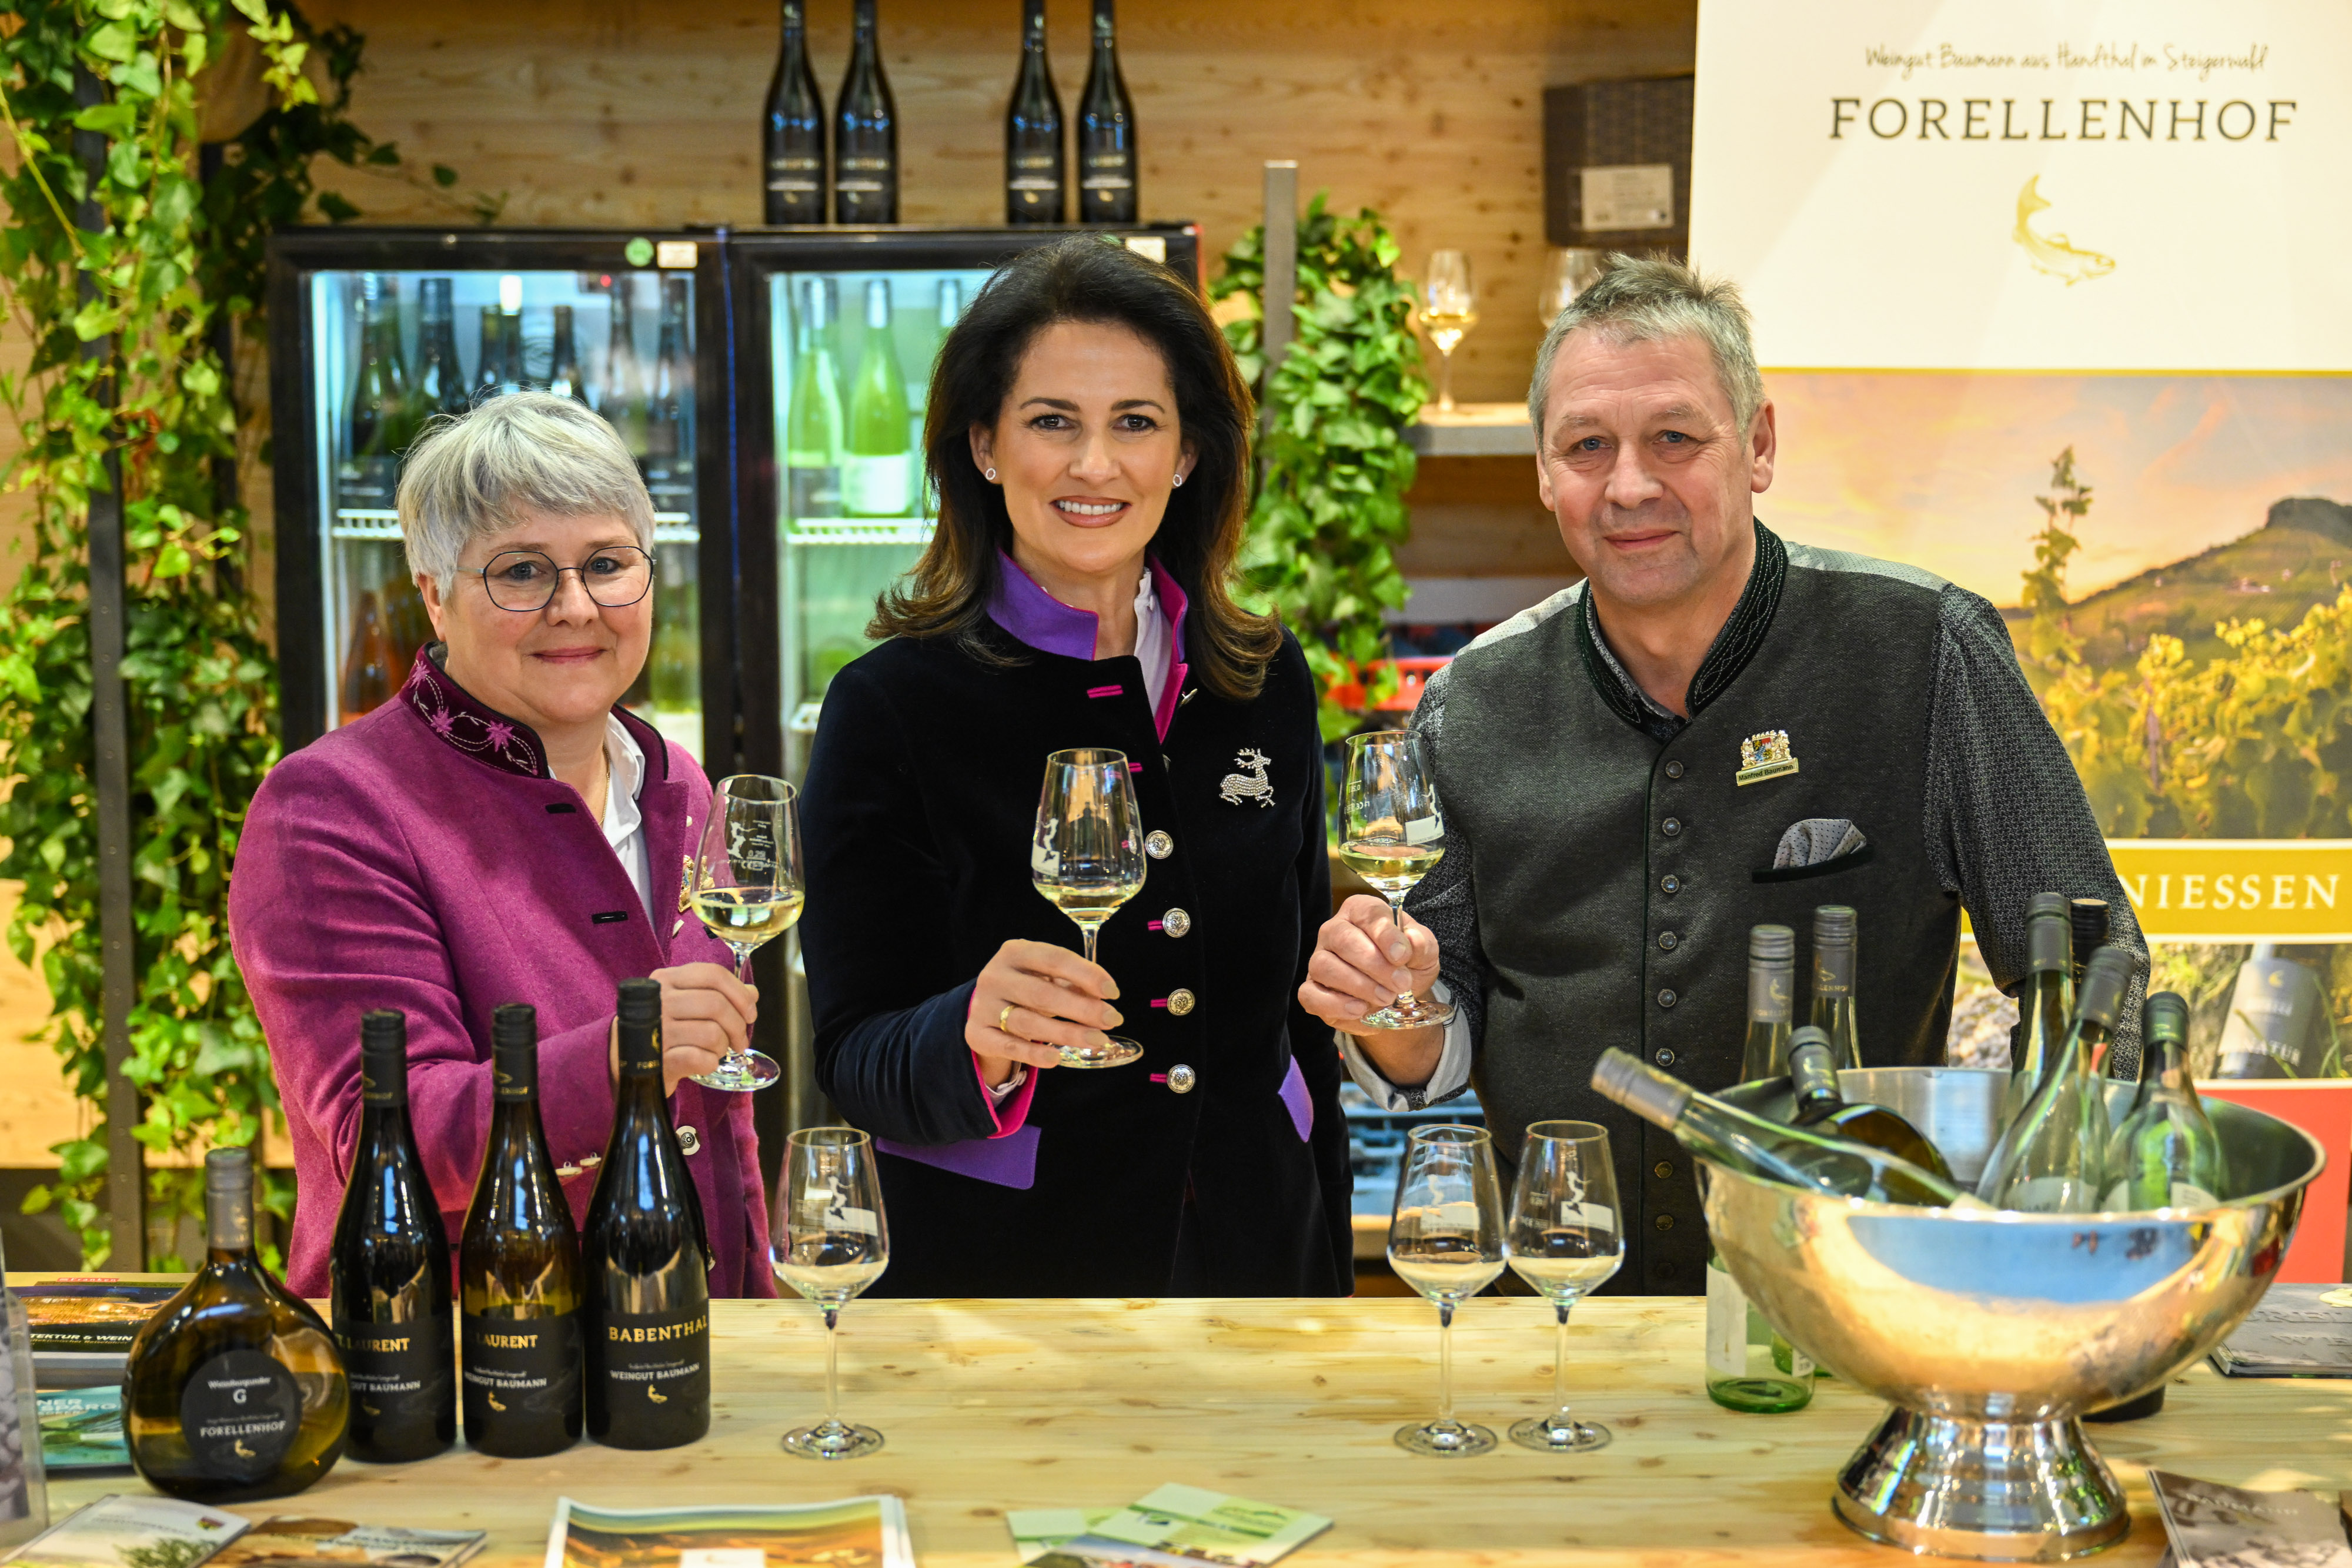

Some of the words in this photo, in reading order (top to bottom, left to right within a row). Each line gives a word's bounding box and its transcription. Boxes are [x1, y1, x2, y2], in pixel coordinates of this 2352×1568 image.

[1866, 42, 1932, 81] Weingut
[1939, 42, 2015, 69] Baumann
[2162, 42, 2270, 83] Steigerwald
[1829, 97, 2297, 142] FORELLENHOF
[1739, 771, 1763, 781] Manfred
[1765, 764, 1793, 775] Baumann
[2118, 874, 2340, 910] NIESSEN
[610, 1370, 654, 1381] WEINGUT
[656, 1362, 700, 1379] BAUMANN
[370, 1380, 421, 1392] BAUMANN
[496, 1378, 547, 1389] BAUMANN
[233, 1388, 247, 1404] G
[200, 1420, 286, 1438] FORELLENHOF
